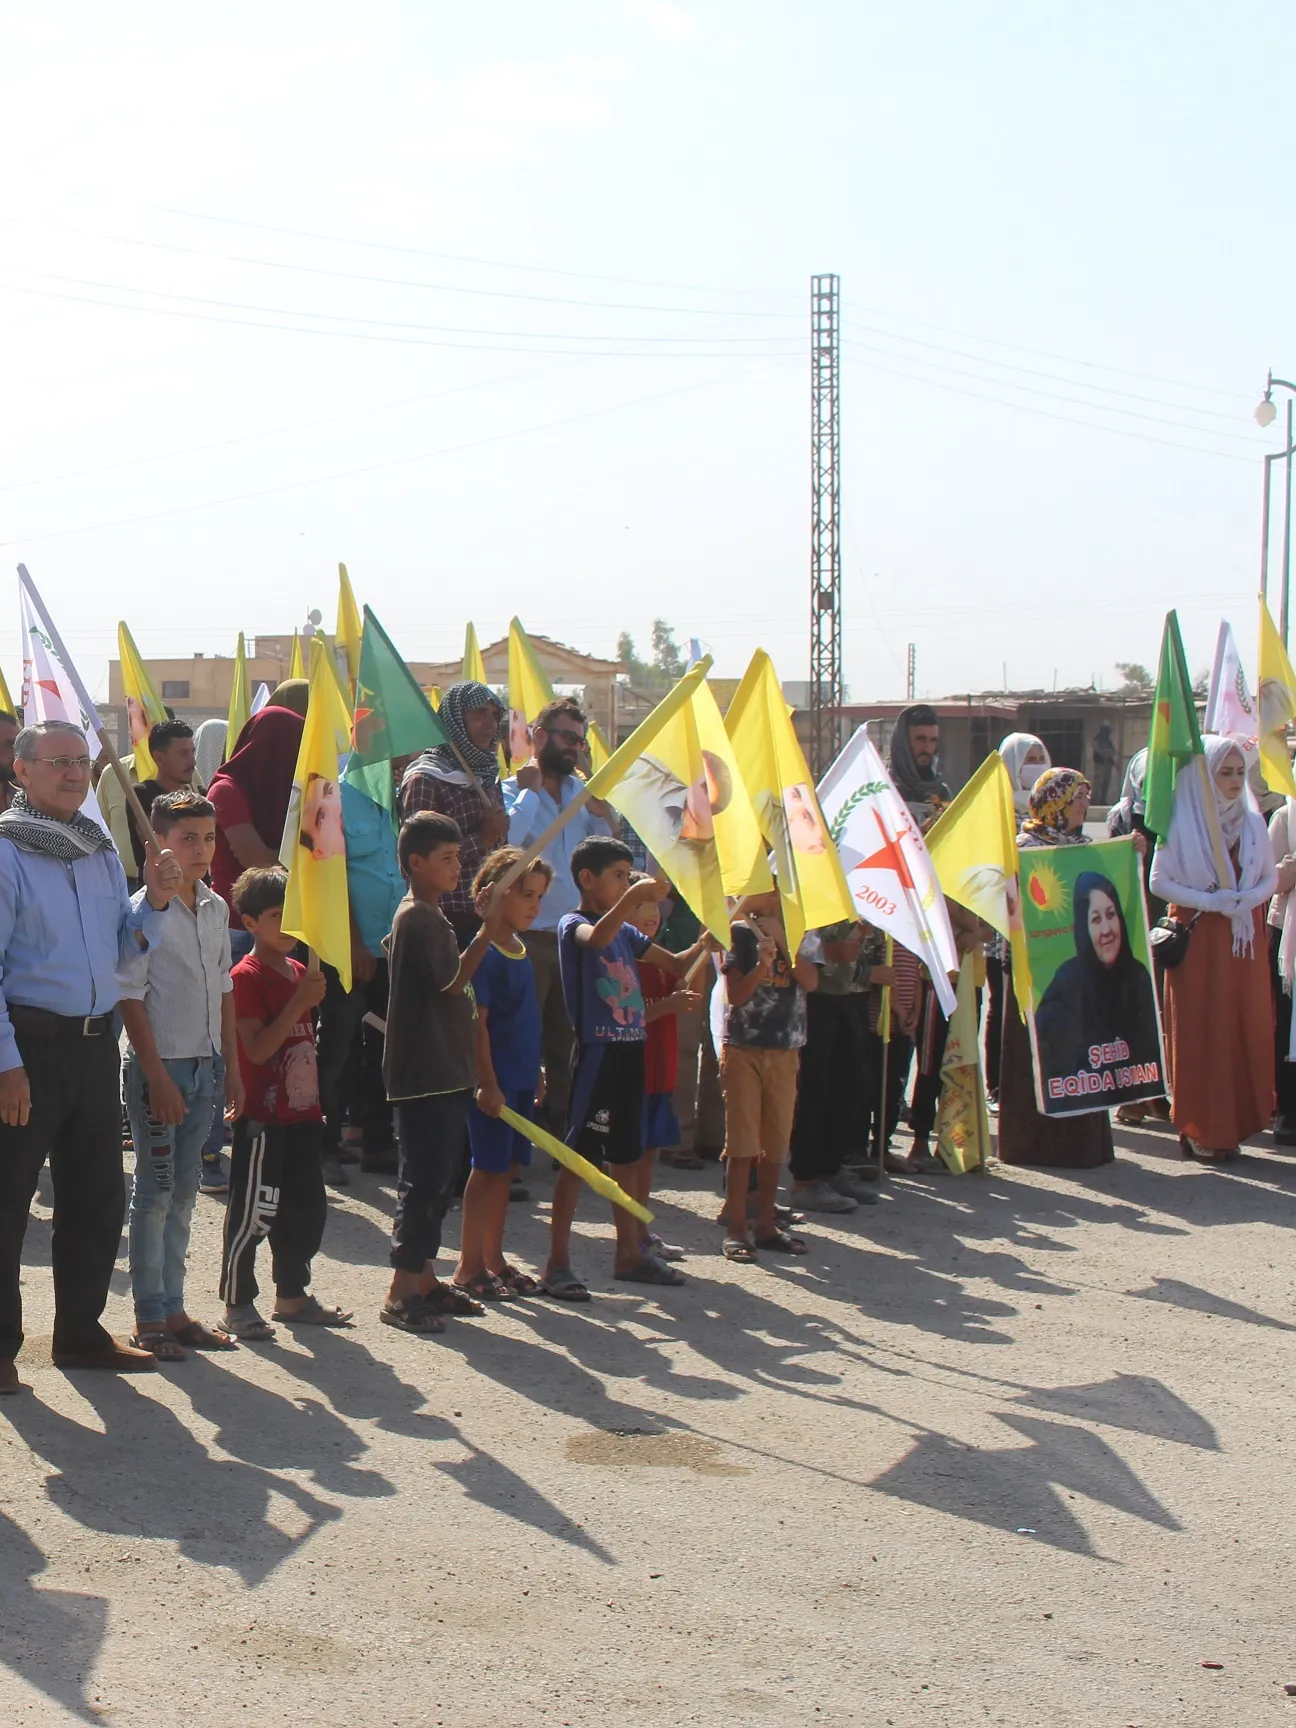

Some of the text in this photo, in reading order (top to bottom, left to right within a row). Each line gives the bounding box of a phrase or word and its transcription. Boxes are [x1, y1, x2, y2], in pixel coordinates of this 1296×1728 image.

[855, 885, 897, 916] 2003
[1048, 1069, 1116, 1098] EQÎDA
[253, 1185, 280, 1236] FILA
